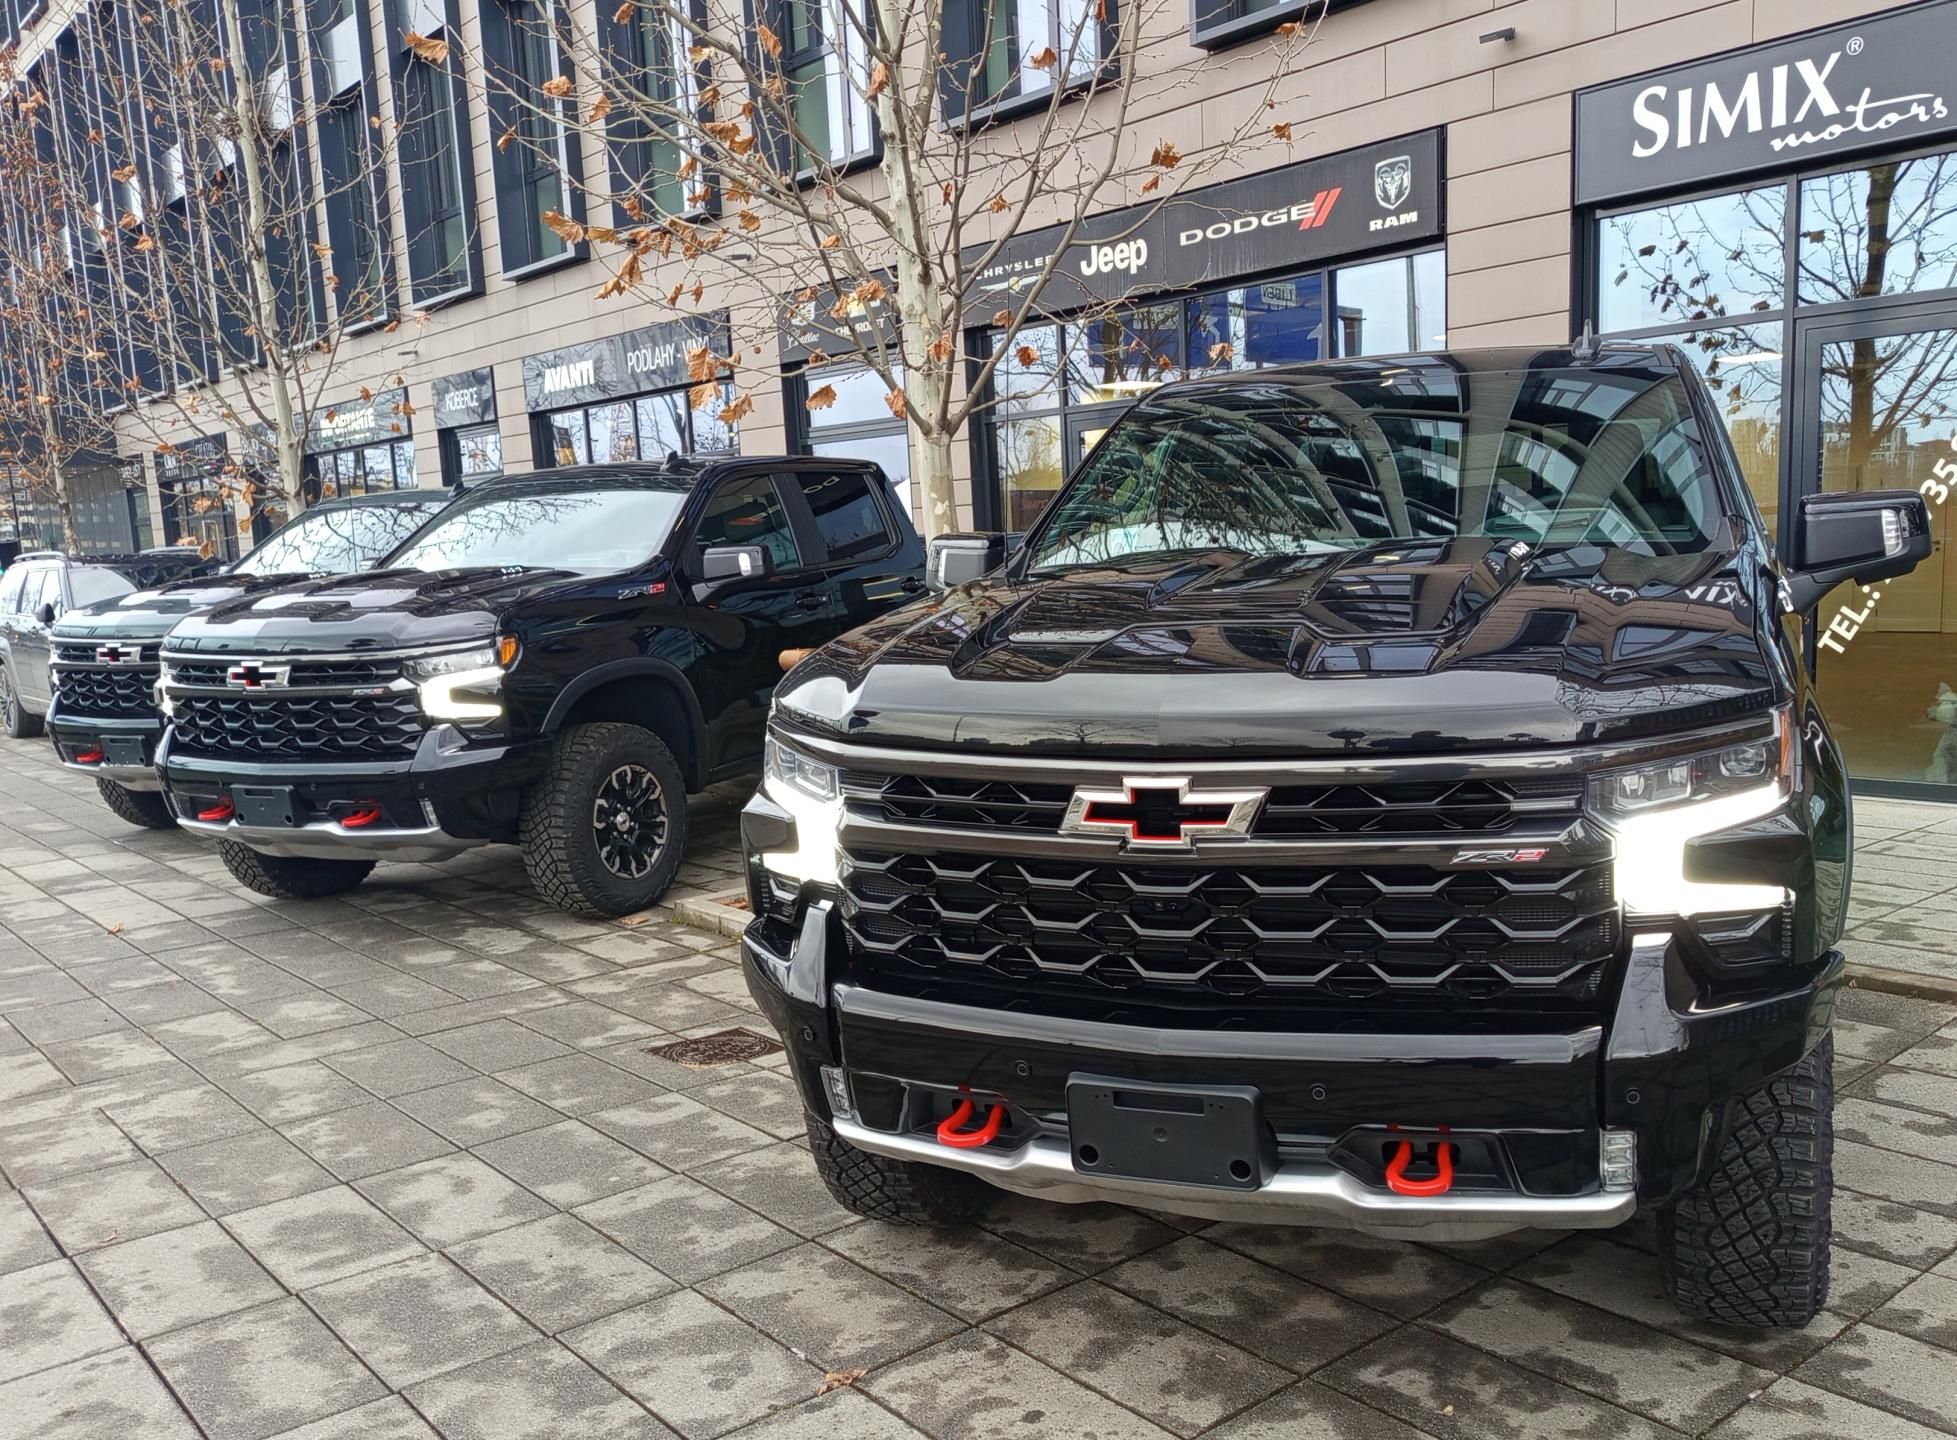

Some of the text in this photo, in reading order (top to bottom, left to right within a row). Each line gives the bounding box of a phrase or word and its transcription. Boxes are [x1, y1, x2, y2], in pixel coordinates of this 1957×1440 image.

[1632, 51, 1842, 158] SIMIX
[1770, 88, 1949, 151] motors
[1179, 201, 1317, 247] DODGE
[1369, 210, 1418, 231] RAM
[1080, 238, 1148, 276] Jeep
[544, 359, 596, 394] AVANTI
[627, 344, 675, 374] PODLAHY
[1919, 434, 1957, 505] 35
[1449, 848, 1549, 865] ZR2
